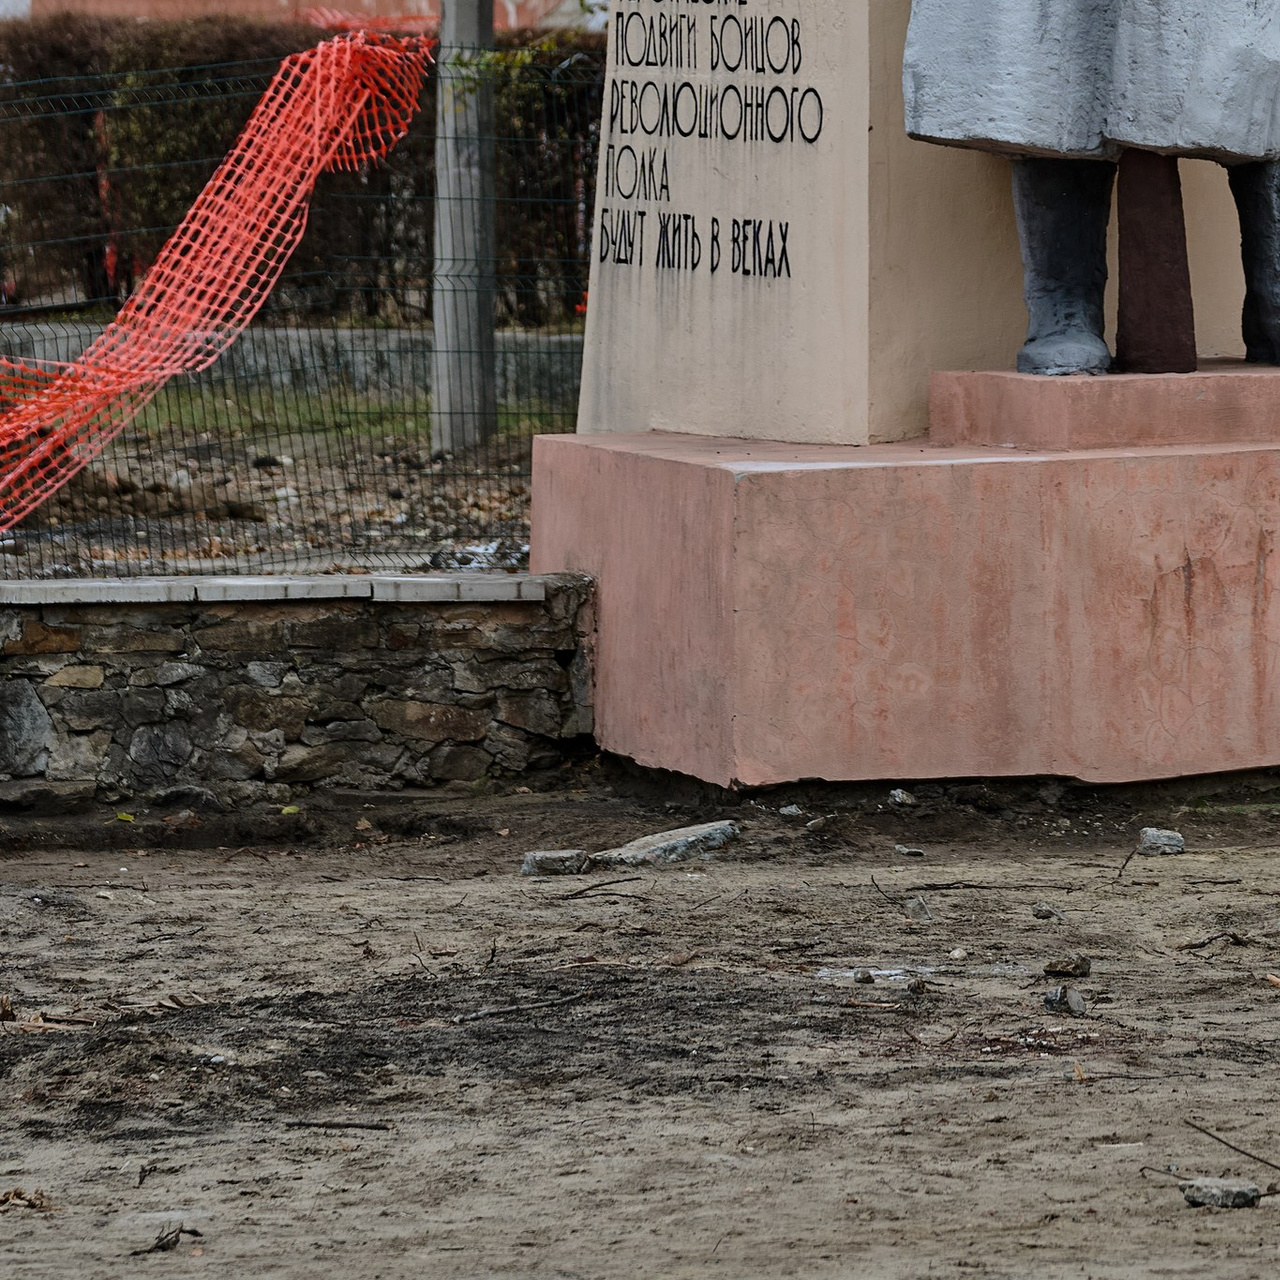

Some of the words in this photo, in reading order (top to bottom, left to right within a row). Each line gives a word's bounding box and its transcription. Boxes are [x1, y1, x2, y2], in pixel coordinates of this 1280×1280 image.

[615, 11, 697, 70] ПОДВИГИ
[610, 78, 823, 143] РЕВОЛЮЦИОННОГО
[605, 142, 671, 203] ПОЛКА
[599, 207, 647, 270] БУДУТ
[655, 211, 702, 275] ЖИТЬ
[709, 216, 721, 277] В
[730, 218, 792, 280] ВЕКАХ
